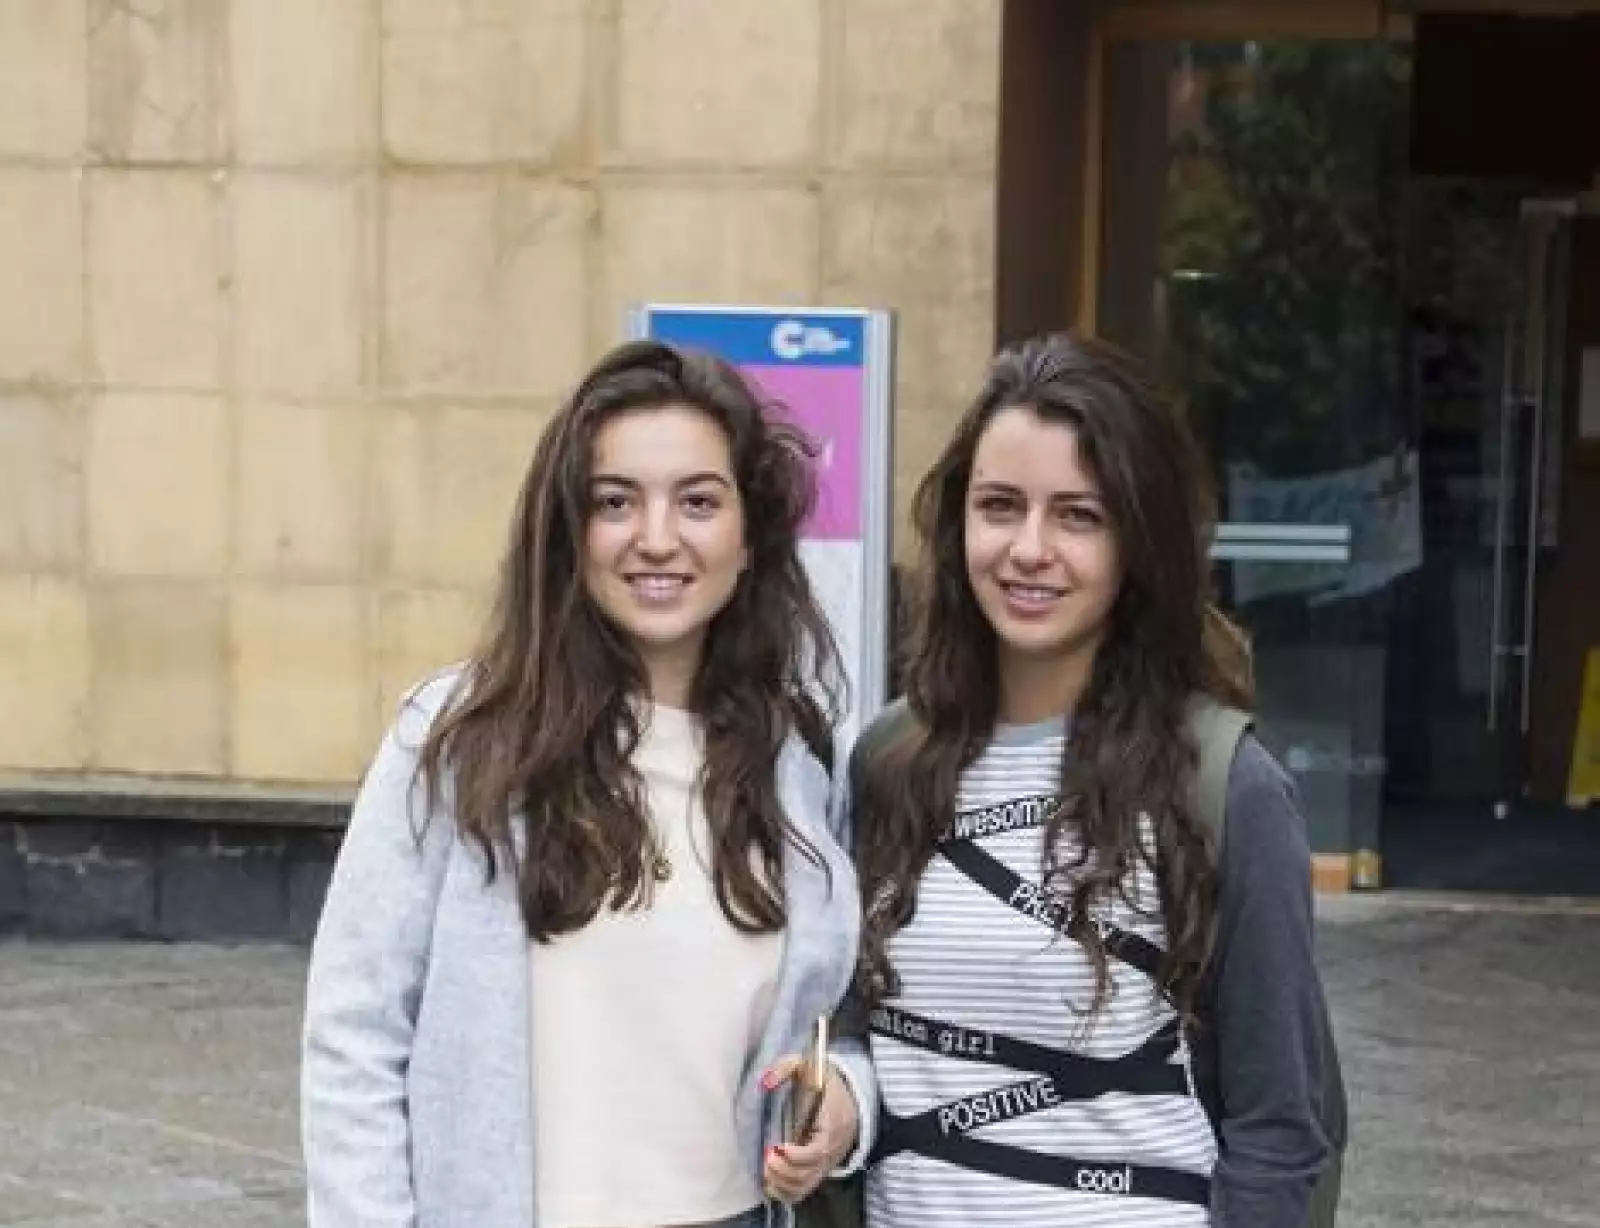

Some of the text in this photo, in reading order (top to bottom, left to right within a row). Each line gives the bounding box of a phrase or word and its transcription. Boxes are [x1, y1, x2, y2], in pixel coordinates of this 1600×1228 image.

[954, 797, 1061, 837] wesome
[937, 1029, 997, 1054] girl
[938, 1076, 1062, 1136] POSITIVE
[1075, 1163, 1133, 1195] cool
